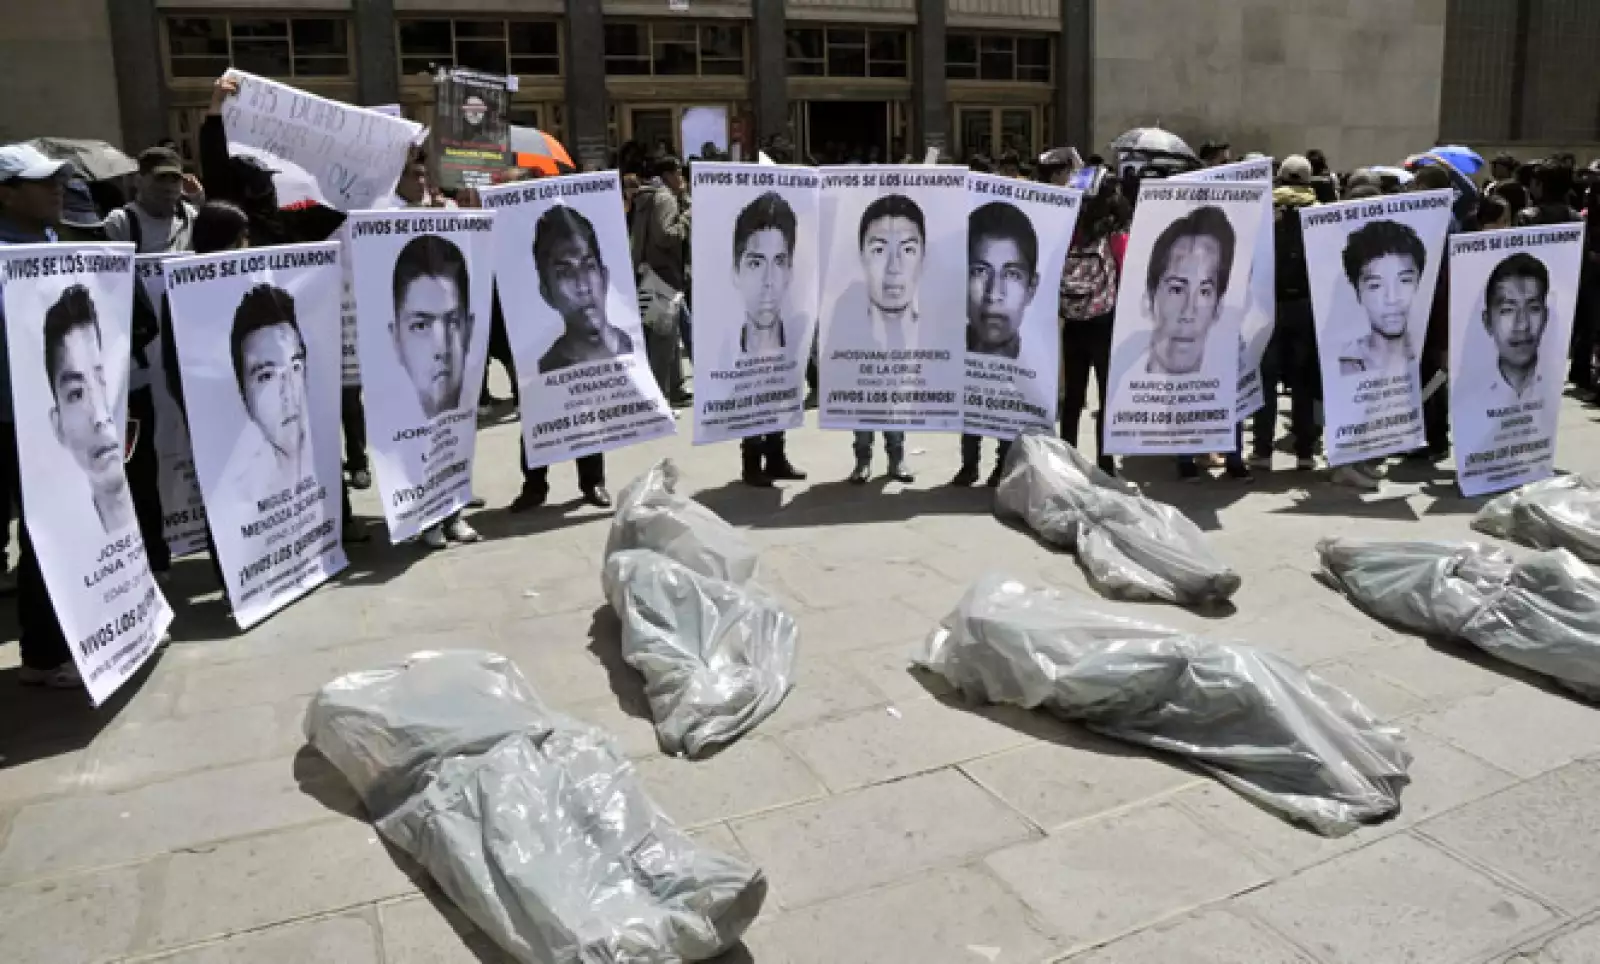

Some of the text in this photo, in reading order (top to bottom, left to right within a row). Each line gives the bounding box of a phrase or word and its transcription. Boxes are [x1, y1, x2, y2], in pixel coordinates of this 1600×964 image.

[735, 172, 749, 187] SE
[751, 172, 774, 187] LOS
[820, 174, 860, 190] ¡VIVOS
[862, 173, 876, 187] SE
[879, 172, 901, 187] LOS
[523, 187, 536, 203] SE
[539, 183, 560, 199] LOS
[991, 182, 1013, 197] LOS
[1190, 187, 1209, 202] LOS
[1344, 207, 1360, 220] SE
[1361, 203, 1384, 218] LOS
[394, 218, 410, 235] SE
[412, 216, 434, 232] LOS
[1503, 234, 1524, 249] LOS
[41, 255, 58, 277] SE
[60, 252, 84, 273] LOS
[219, 258, 237, 278] SE
[240, 253, 266, 274] LOS
[268, 249, 337, 271] LLEVARON!
[859, 363, 922, 375] DE LA CRUZ
[568, 375, 628, 396] VENANCIO
[866, 390, 888, 404] LOS
[532, 416, 571, 440] ¡VIVOS
[573, 410, 596, 427] LOS
[1151, 410, 1172, 425] LOS
[273, 543, 292, 566] LOS
[115, 608, 137, 637] LOS
